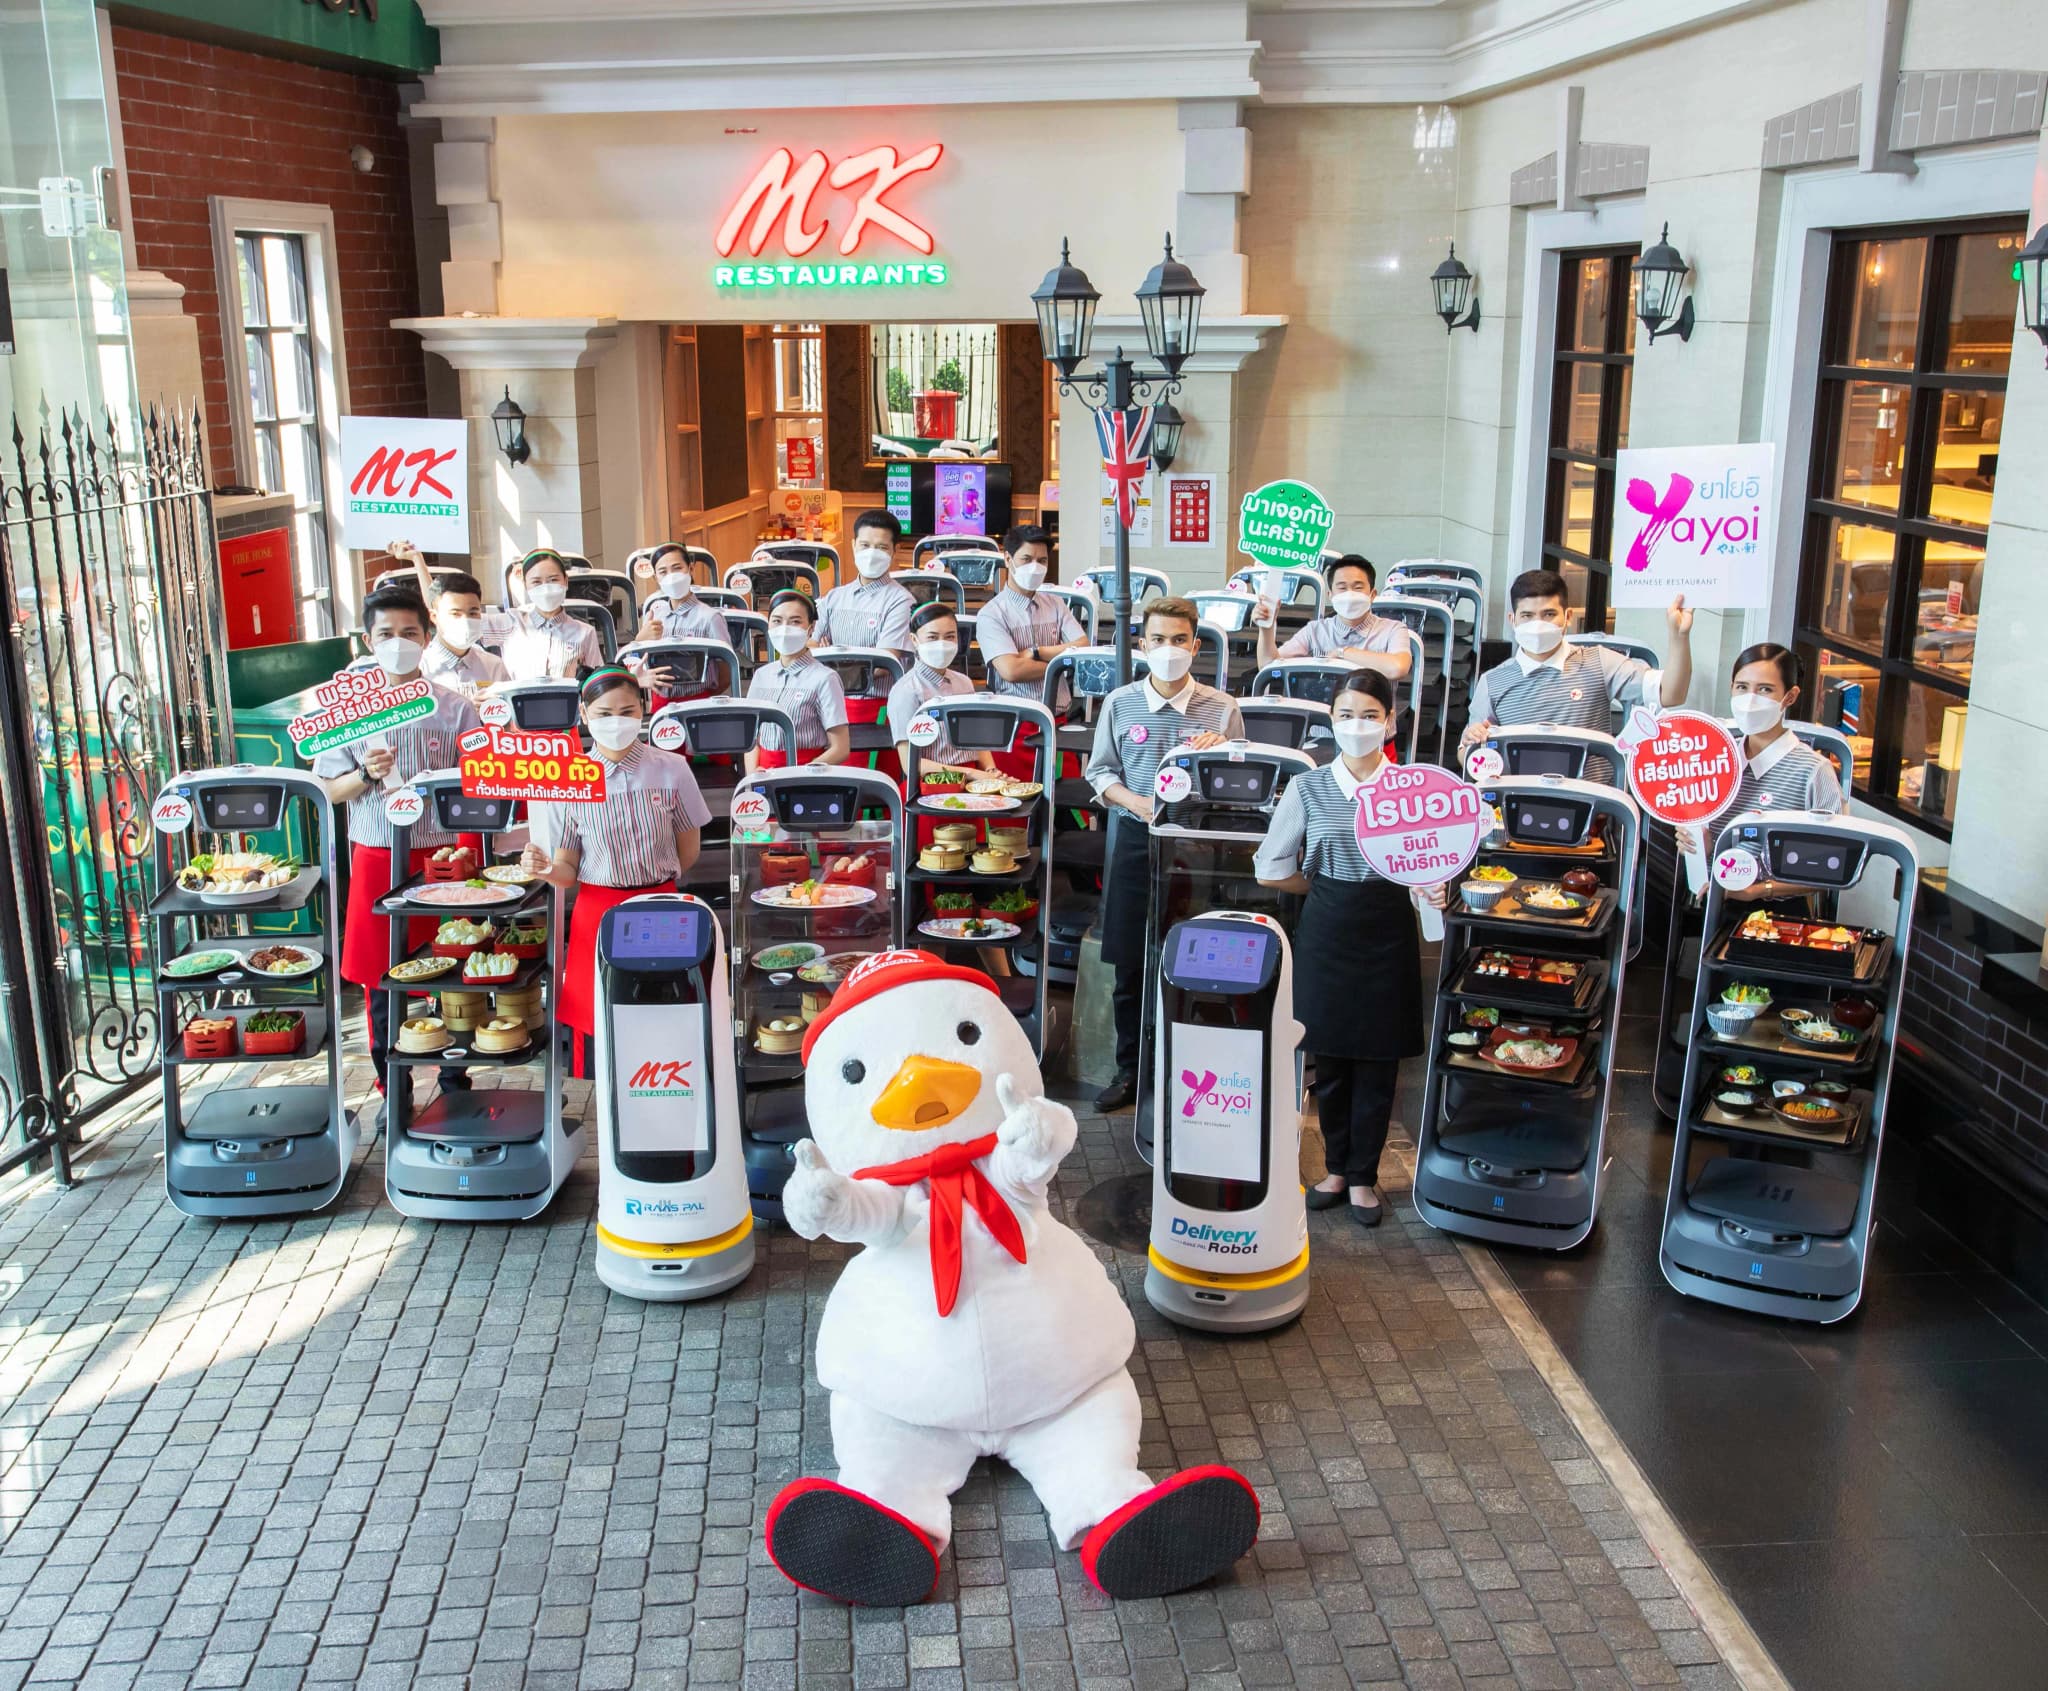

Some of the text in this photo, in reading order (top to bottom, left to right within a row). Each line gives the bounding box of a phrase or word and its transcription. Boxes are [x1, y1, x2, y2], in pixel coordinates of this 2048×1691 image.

[715, 144, 944, 257] MK
[714, 264, 946, 286] RESTAURANTS
[350, 446, 457, 499] MK
[1700, 468, 1760, 499] ยาโยอิ
[351, 501, 458, 515] RESTAURANTS
[1244, 496, 1331, 527] มาเจอกัน
[1248, 520, 1319, 547] นะคร้าบ
[1626, 473, 1759, 572] Yayoi
[232, 547, 272, 566] FIRE HOSE
[1242, 540, 1318, 566] พวกเรารออยู่
[1624, 578, 1662, 586] JAPANESE
[318, 669, 385, 707] พร้อม
[290, 682, 429, 740] ช่วยเสิร์ฟอีกแรง
[484, 705, 506, 715] MK
[308, 704, 427, 753] เพื่อลดสัมผัสนะคร้าบบบ
[656, 726, 680, 738] MK
[911, 722, 934, 733] MK
[463, 727, 569, 756] พบกับ โรบอท
[1653, 732, 1708, 755] พร้อม
[465, 753, 600, 781] กว่า 500 ตัว
[1638, 747, 1730, 783] เสิร์ฟเต็มที่
[476, 780, 592, 799] ทั่วประเทศได้แล้ววันนี้
[1383, 769, 1424, 790] น้อง
[1655, 777, 1718, 808] คร้าบบบ
[157, 804, 186, 817] MK
[390, 799, 418, 811] MK
[736, 799, 763, 814] MK
[1359, 787, 1477, 828] โรบอท
[1403, 831, 1438, 852] ยินดี
[1385, 852, 1459, 874] ให้บริการ
[629, 1061, 692, 1088] MK
[1182, 1070, 1251, 1117] Yayoi
[683, 1202, 704, 1211] PAL
[1171, 1217, 1256, 1245] Delivery
[1208, 1242, 1258, 1254] Robot
